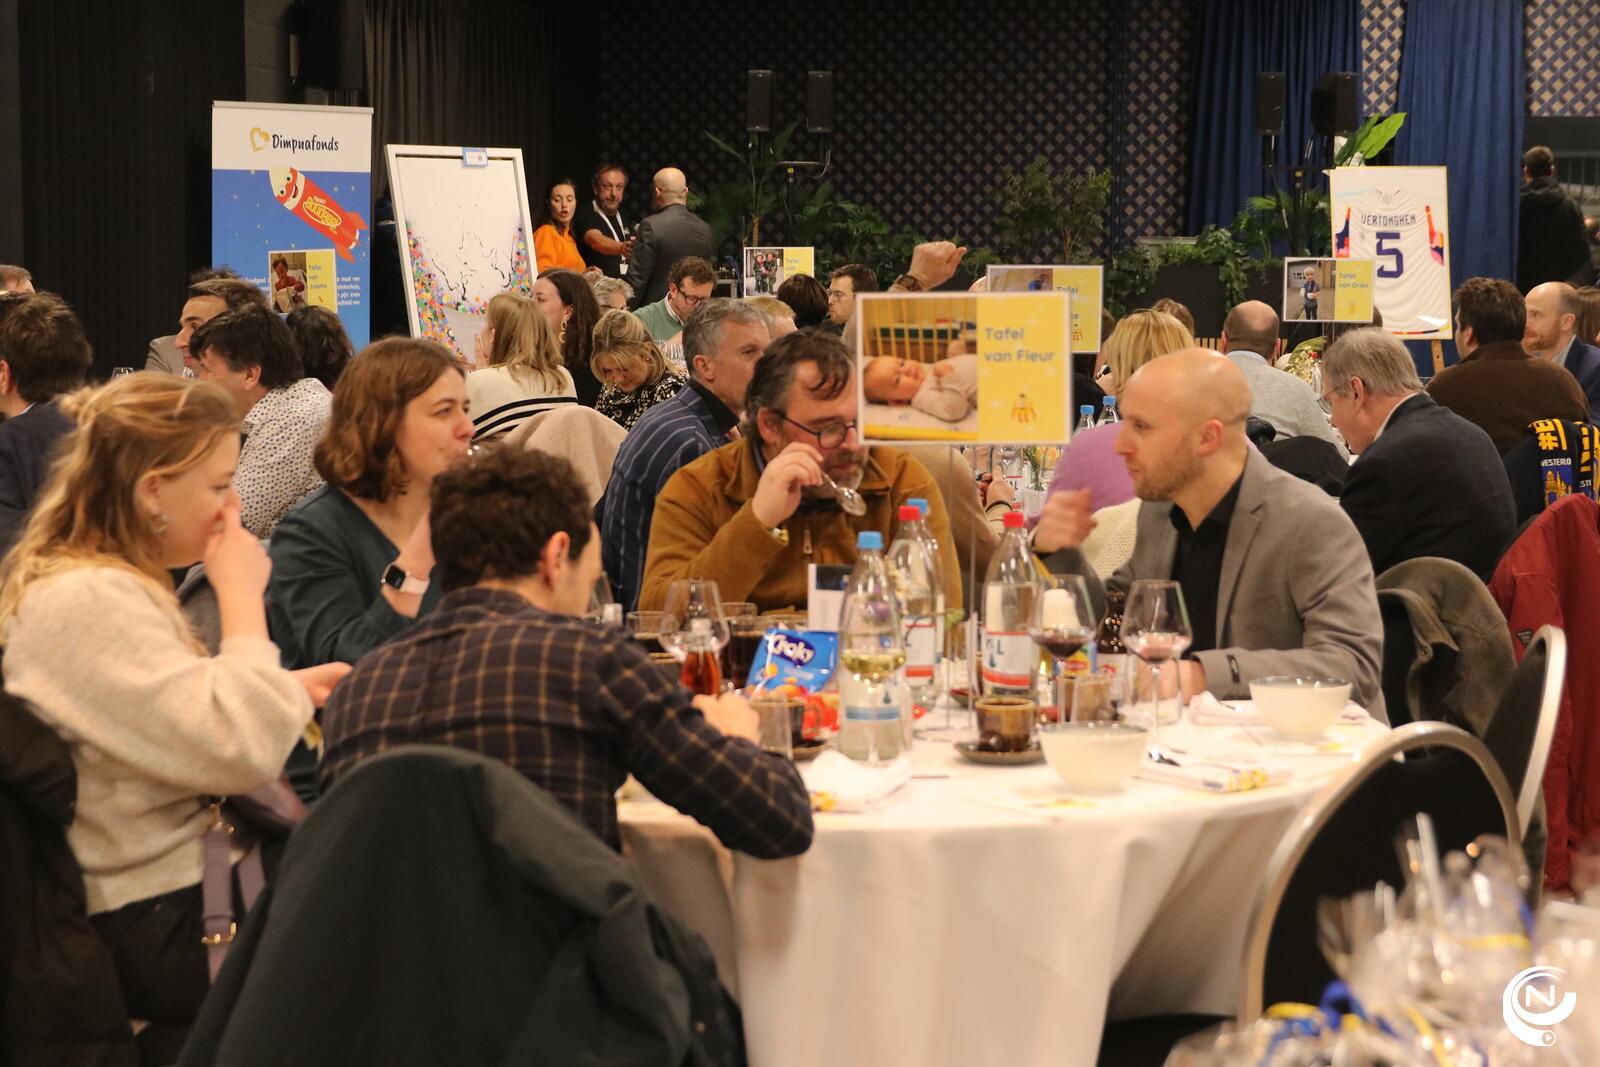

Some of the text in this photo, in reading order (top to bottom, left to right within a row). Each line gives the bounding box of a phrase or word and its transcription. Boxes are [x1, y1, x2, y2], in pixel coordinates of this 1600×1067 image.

[272, 134, 339, 154] Dimpnafonds
[1376, 232, 1404, 278] 5
[984, 327, 1025, 340] Tafel
[984, 349, 1055, 362] van Fleur
